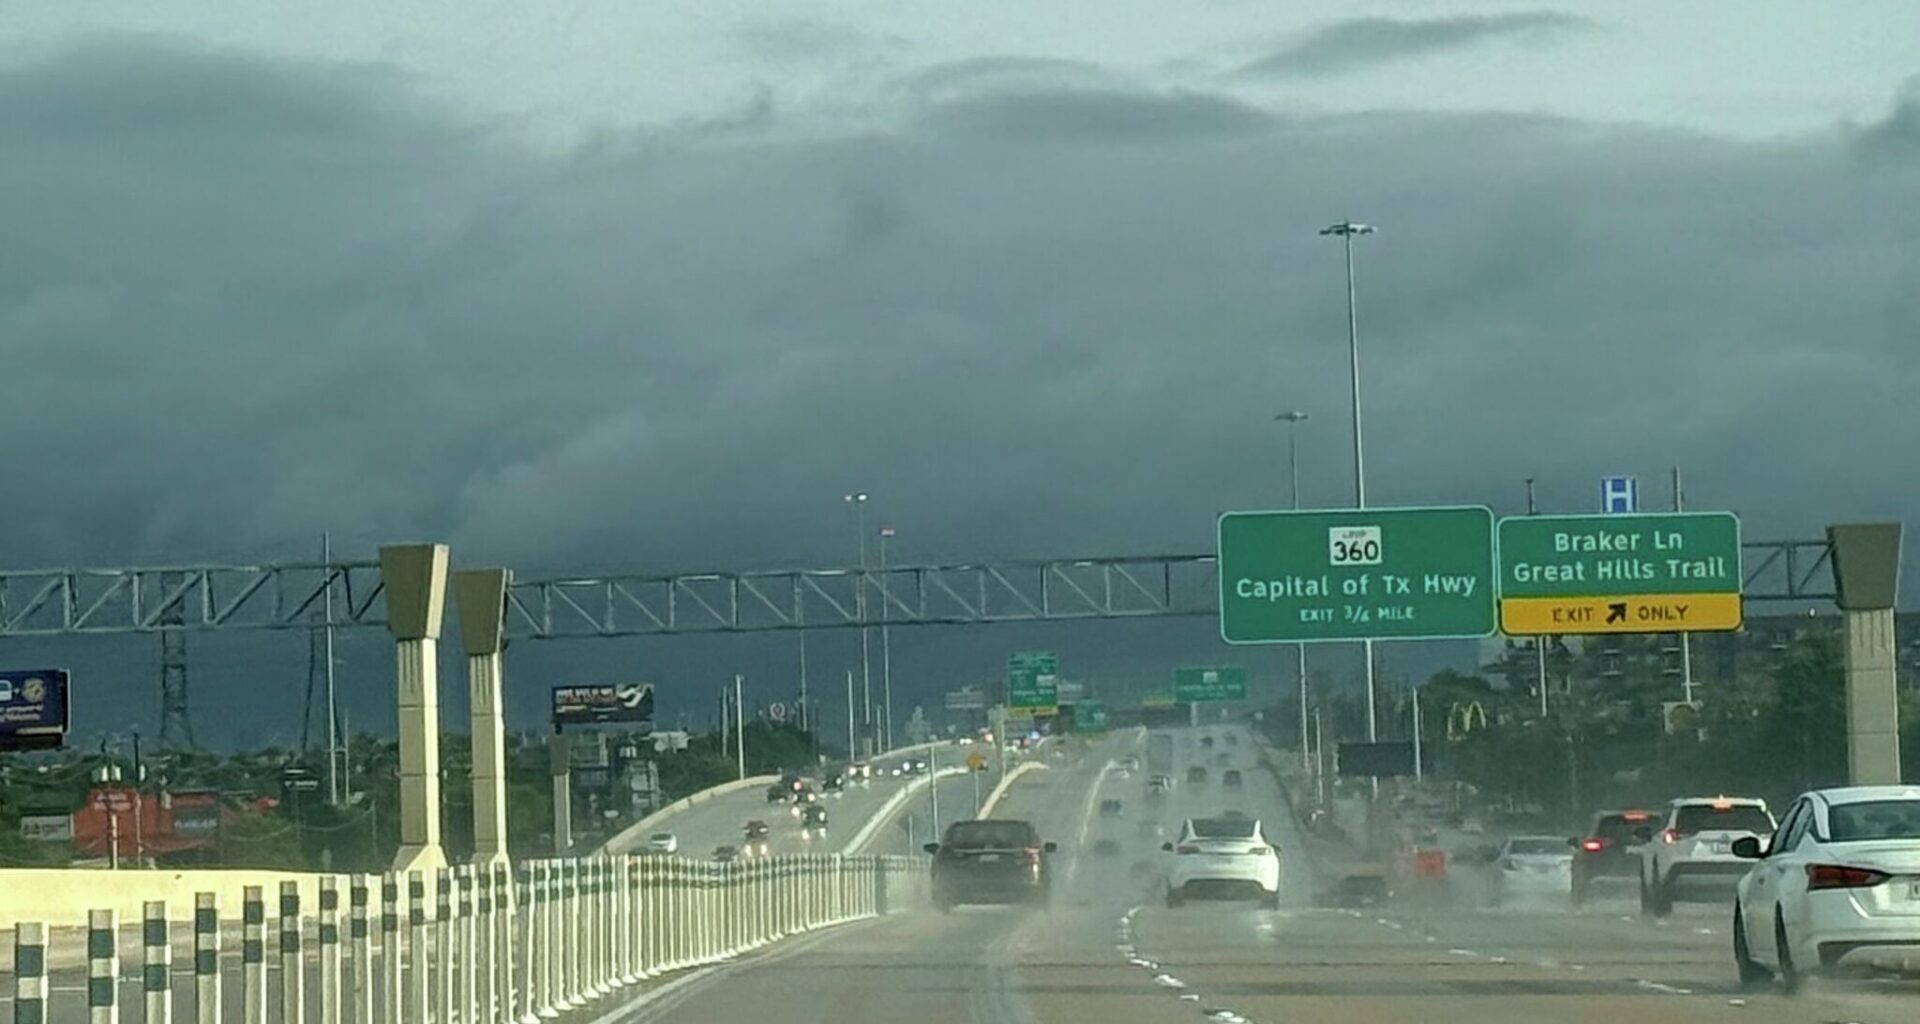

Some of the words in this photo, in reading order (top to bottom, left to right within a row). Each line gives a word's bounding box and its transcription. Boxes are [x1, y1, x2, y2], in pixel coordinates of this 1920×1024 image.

[1605, 478, 1634, 513] H
[1333, 540, 1379, 562] 360
[1554, 530, 1641, 552] Braker
[1654, 530, 1683, 550] Ln
[1513, 560, 1586, 583] Great
[1597, 558, 1655, 580] Hills
[1666, 556, 1727, 579] Trail
[1236, 575, 1330, 602] Capital
[1342, 574, 1370, 596] of
[1382, 575, 1411, 595] Tx
[1424, 573, 1477, 598] Hwy
[1300, 608, 1335, 623] EXIT
[1377, 605, 1416, 621] MILE
[1552, 606, 1594, 623] EXIT
[1637, 604, 1690, 622] ONLY
